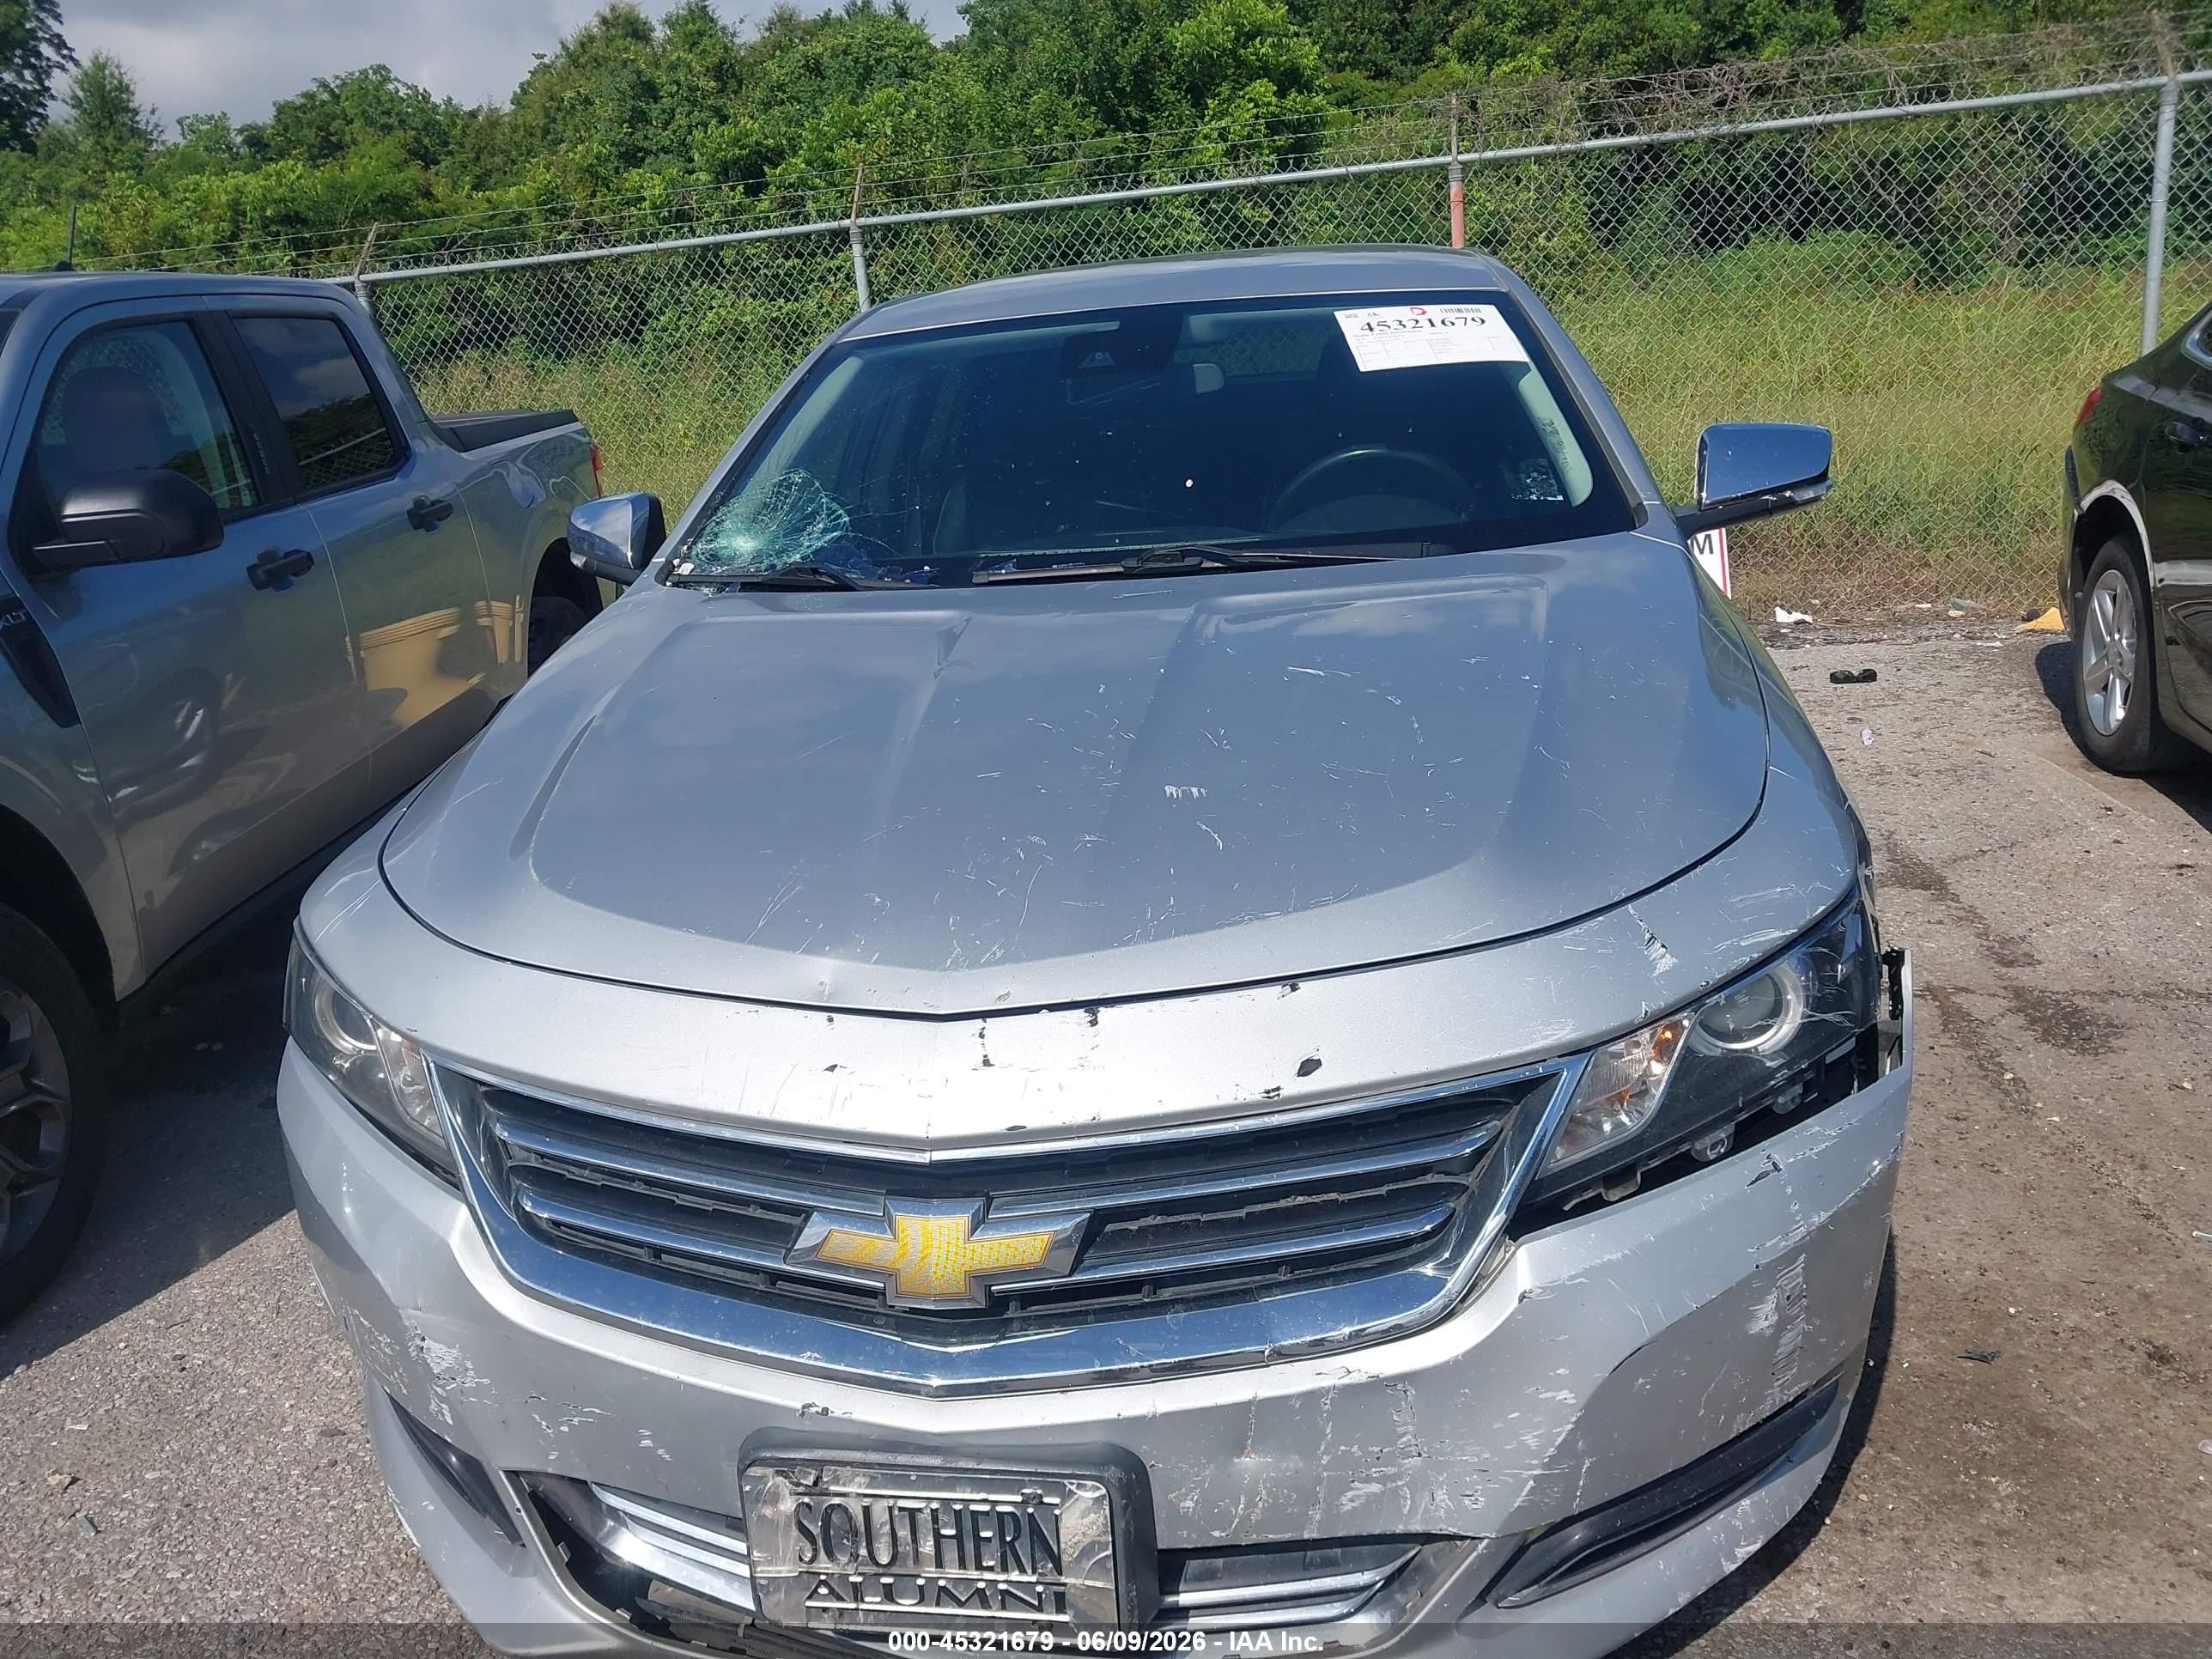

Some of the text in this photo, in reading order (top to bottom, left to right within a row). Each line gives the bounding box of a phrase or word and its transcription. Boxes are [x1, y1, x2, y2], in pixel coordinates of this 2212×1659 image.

[1359, 316, 1486, 333] 45321679
[793, 1498, 1064, 1577] SOUTHERN
[805, 1575, 1068, 1615] ALUMNI
